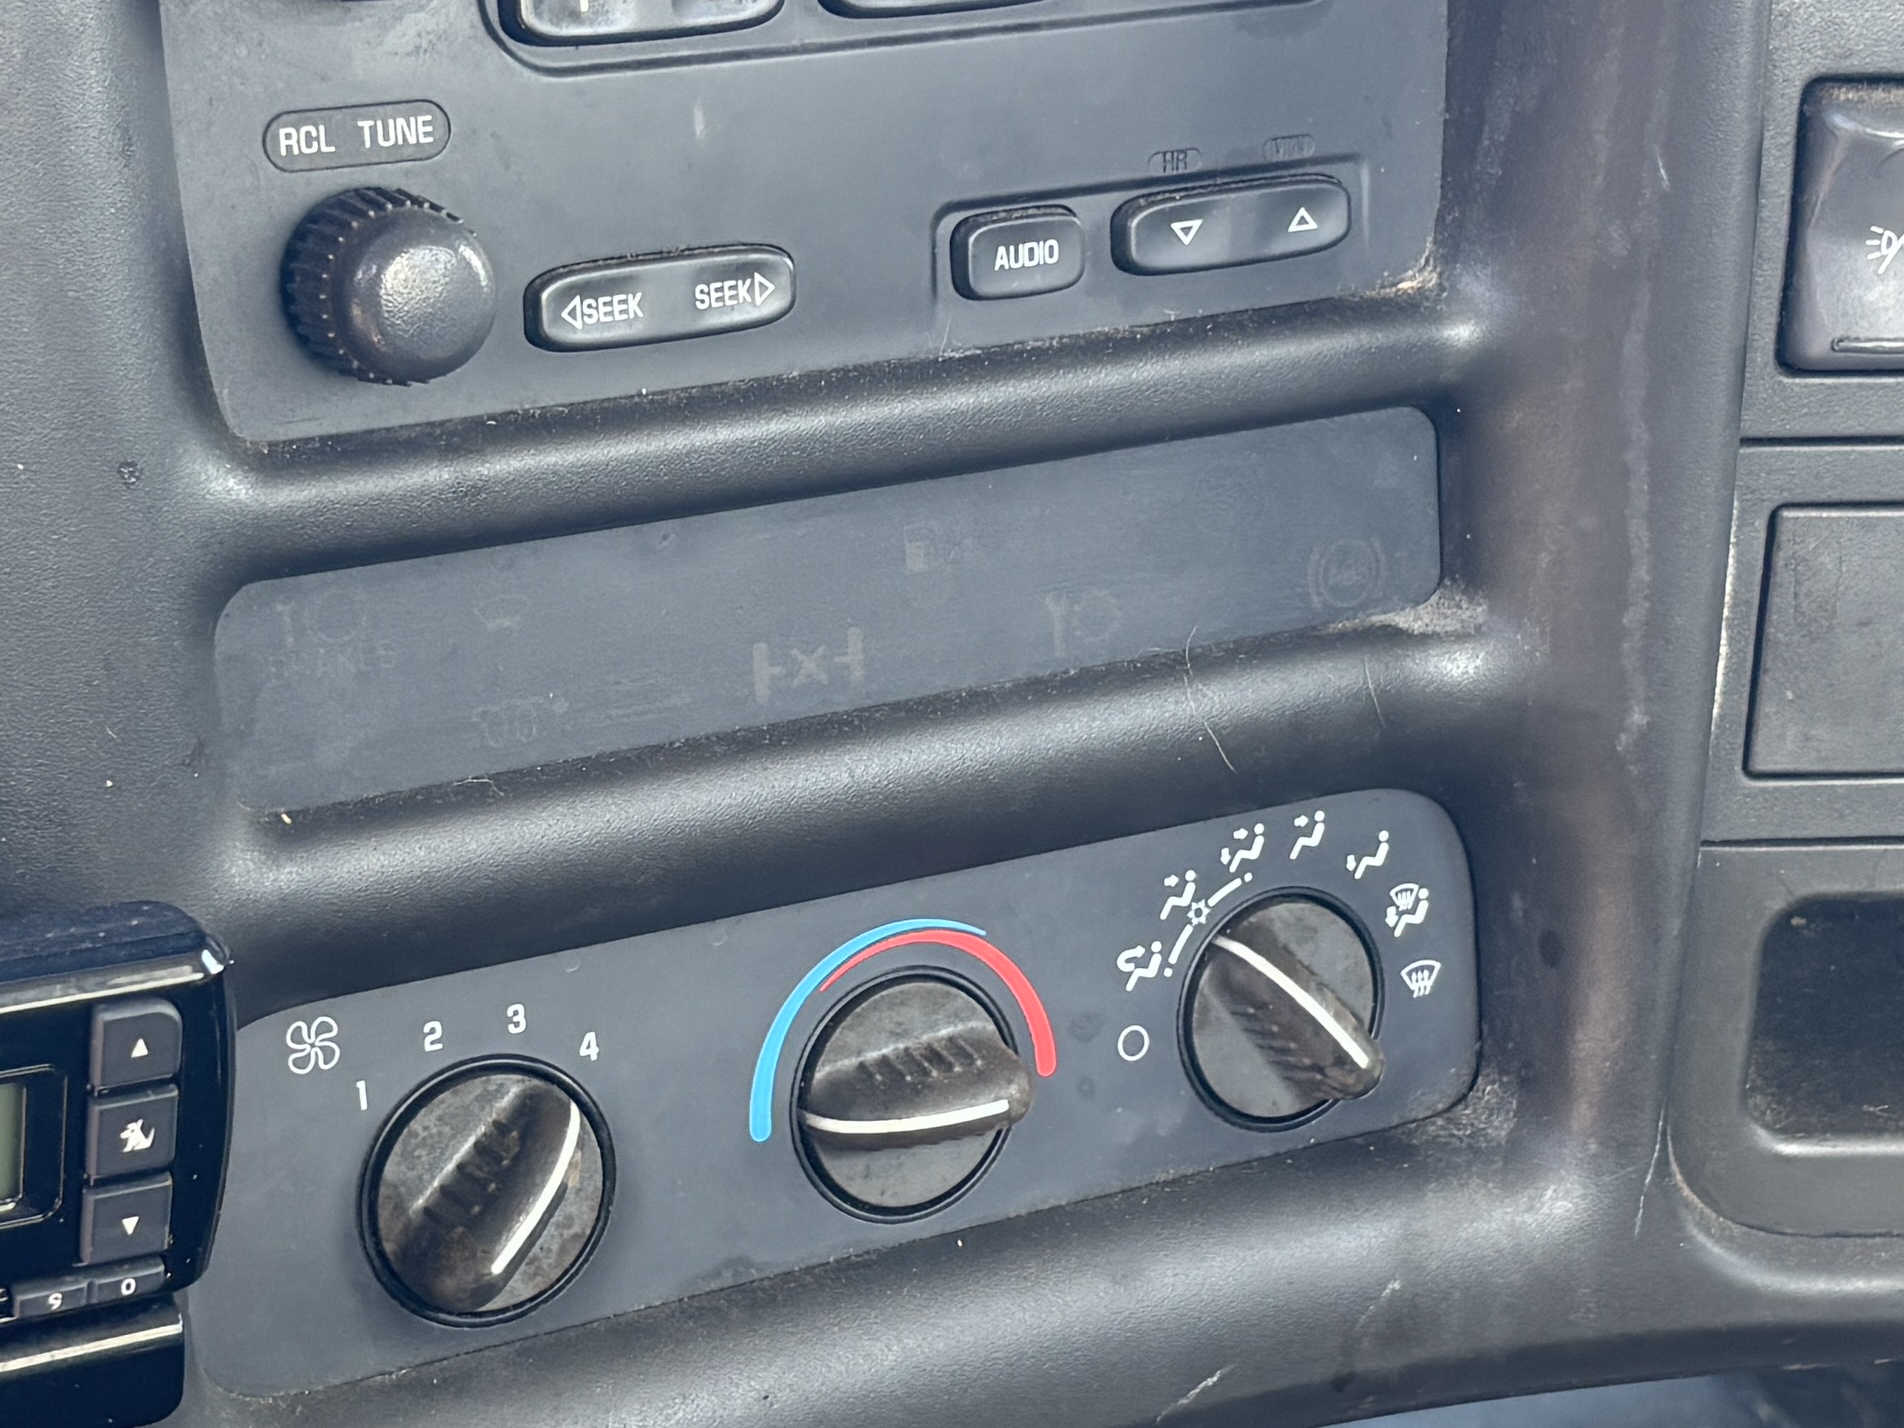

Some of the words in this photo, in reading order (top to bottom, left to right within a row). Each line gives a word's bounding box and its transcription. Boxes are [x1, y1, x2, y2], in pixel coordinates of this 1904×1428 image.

[278, 125, 336, 157] RCL
[357, 114, 434, 149] TUNE
[994, 238, 1060, 272] AUDIO
[581, 291, 644, 323] SEEK
[694, 278, 752, 311] SEEK
[355, 1079, 368, 1111] 1
[422, 1019, 444, 1052] 2
[506, 1003, 528, 1034] 3
[579, 1030, 600, 1061] 4
[47, 1292, 63, 1311] 9
[120, 1277, 137, 1297] 0
